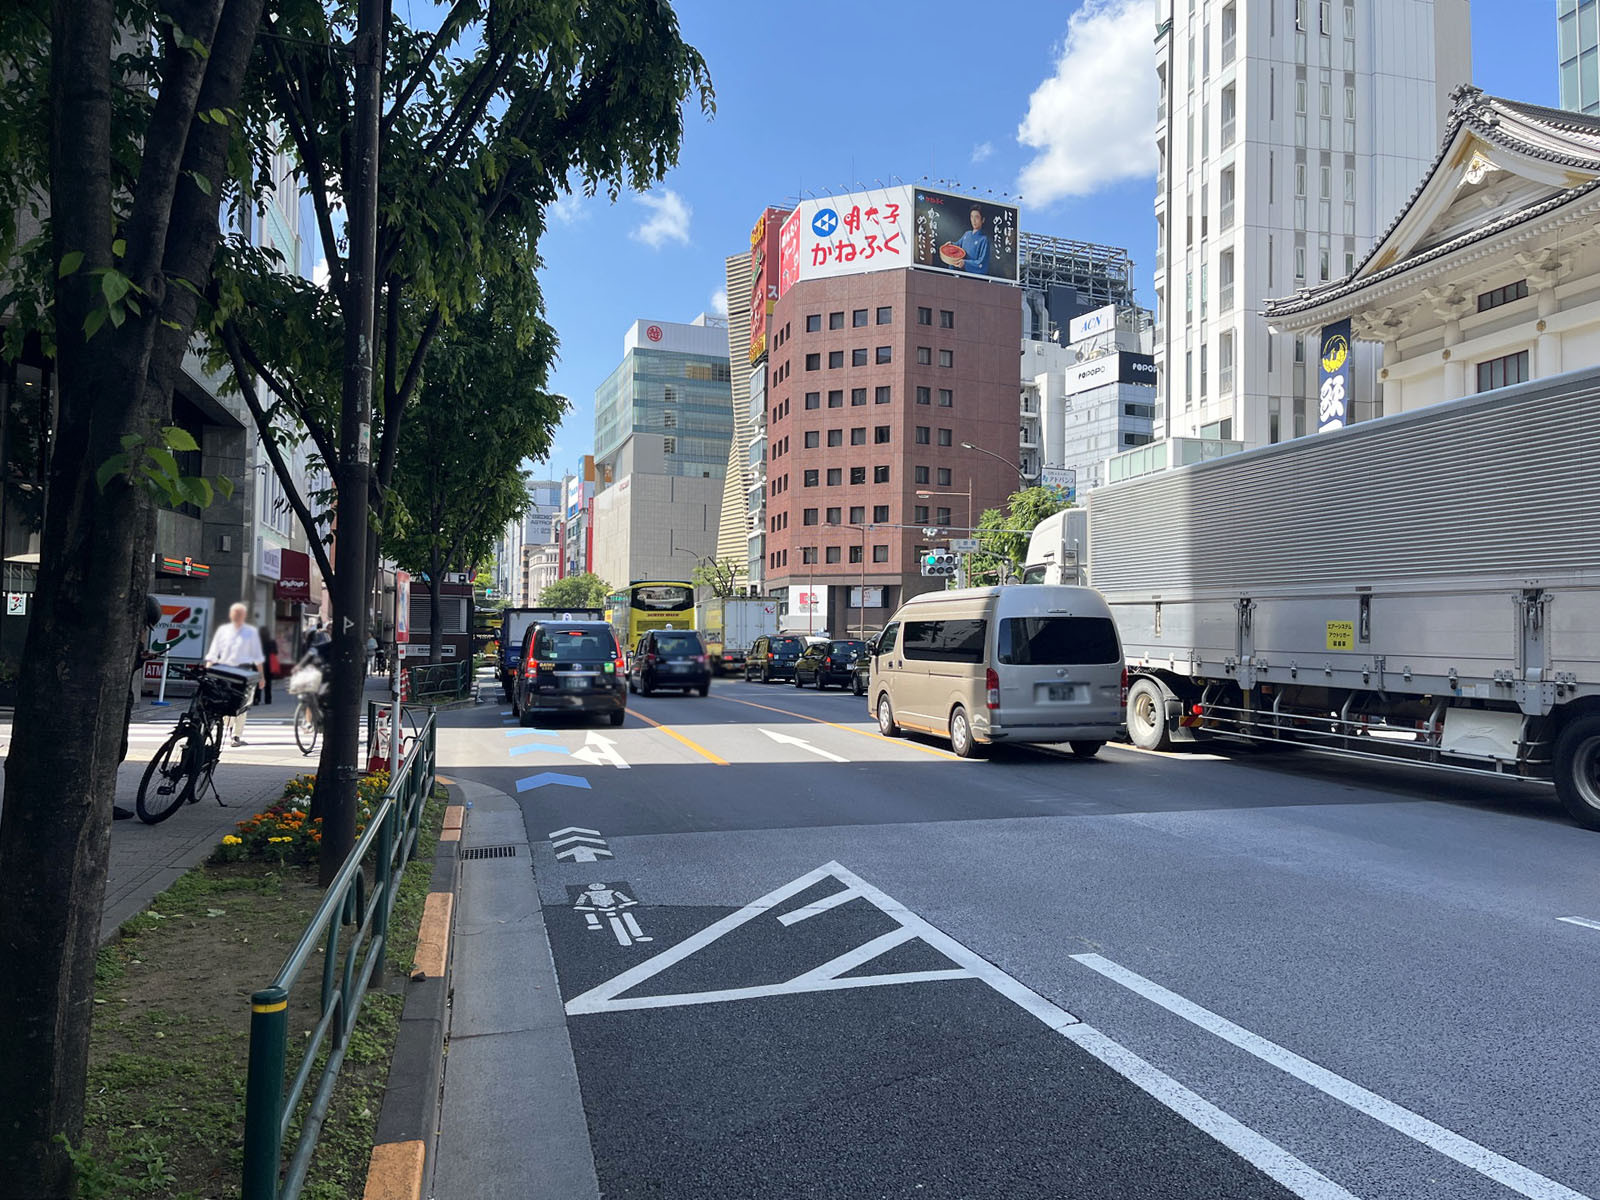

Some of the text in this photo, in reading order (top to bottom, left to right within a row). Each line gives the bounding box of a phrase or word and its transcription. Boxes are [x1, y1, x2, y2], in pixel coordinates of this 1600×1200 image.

[843, 204, 900, 235] 明太子
[916, 215, 927, 261] めんたいこ
[927, 207, 940, 254] かねふくの
[992, 215, 1007, 260] めんたいこ
[1003, 209, 1019, 254] にっぽんの
[811, 231, 900, 267] かねふく
[1080, 314, 1103, 333] ACN
